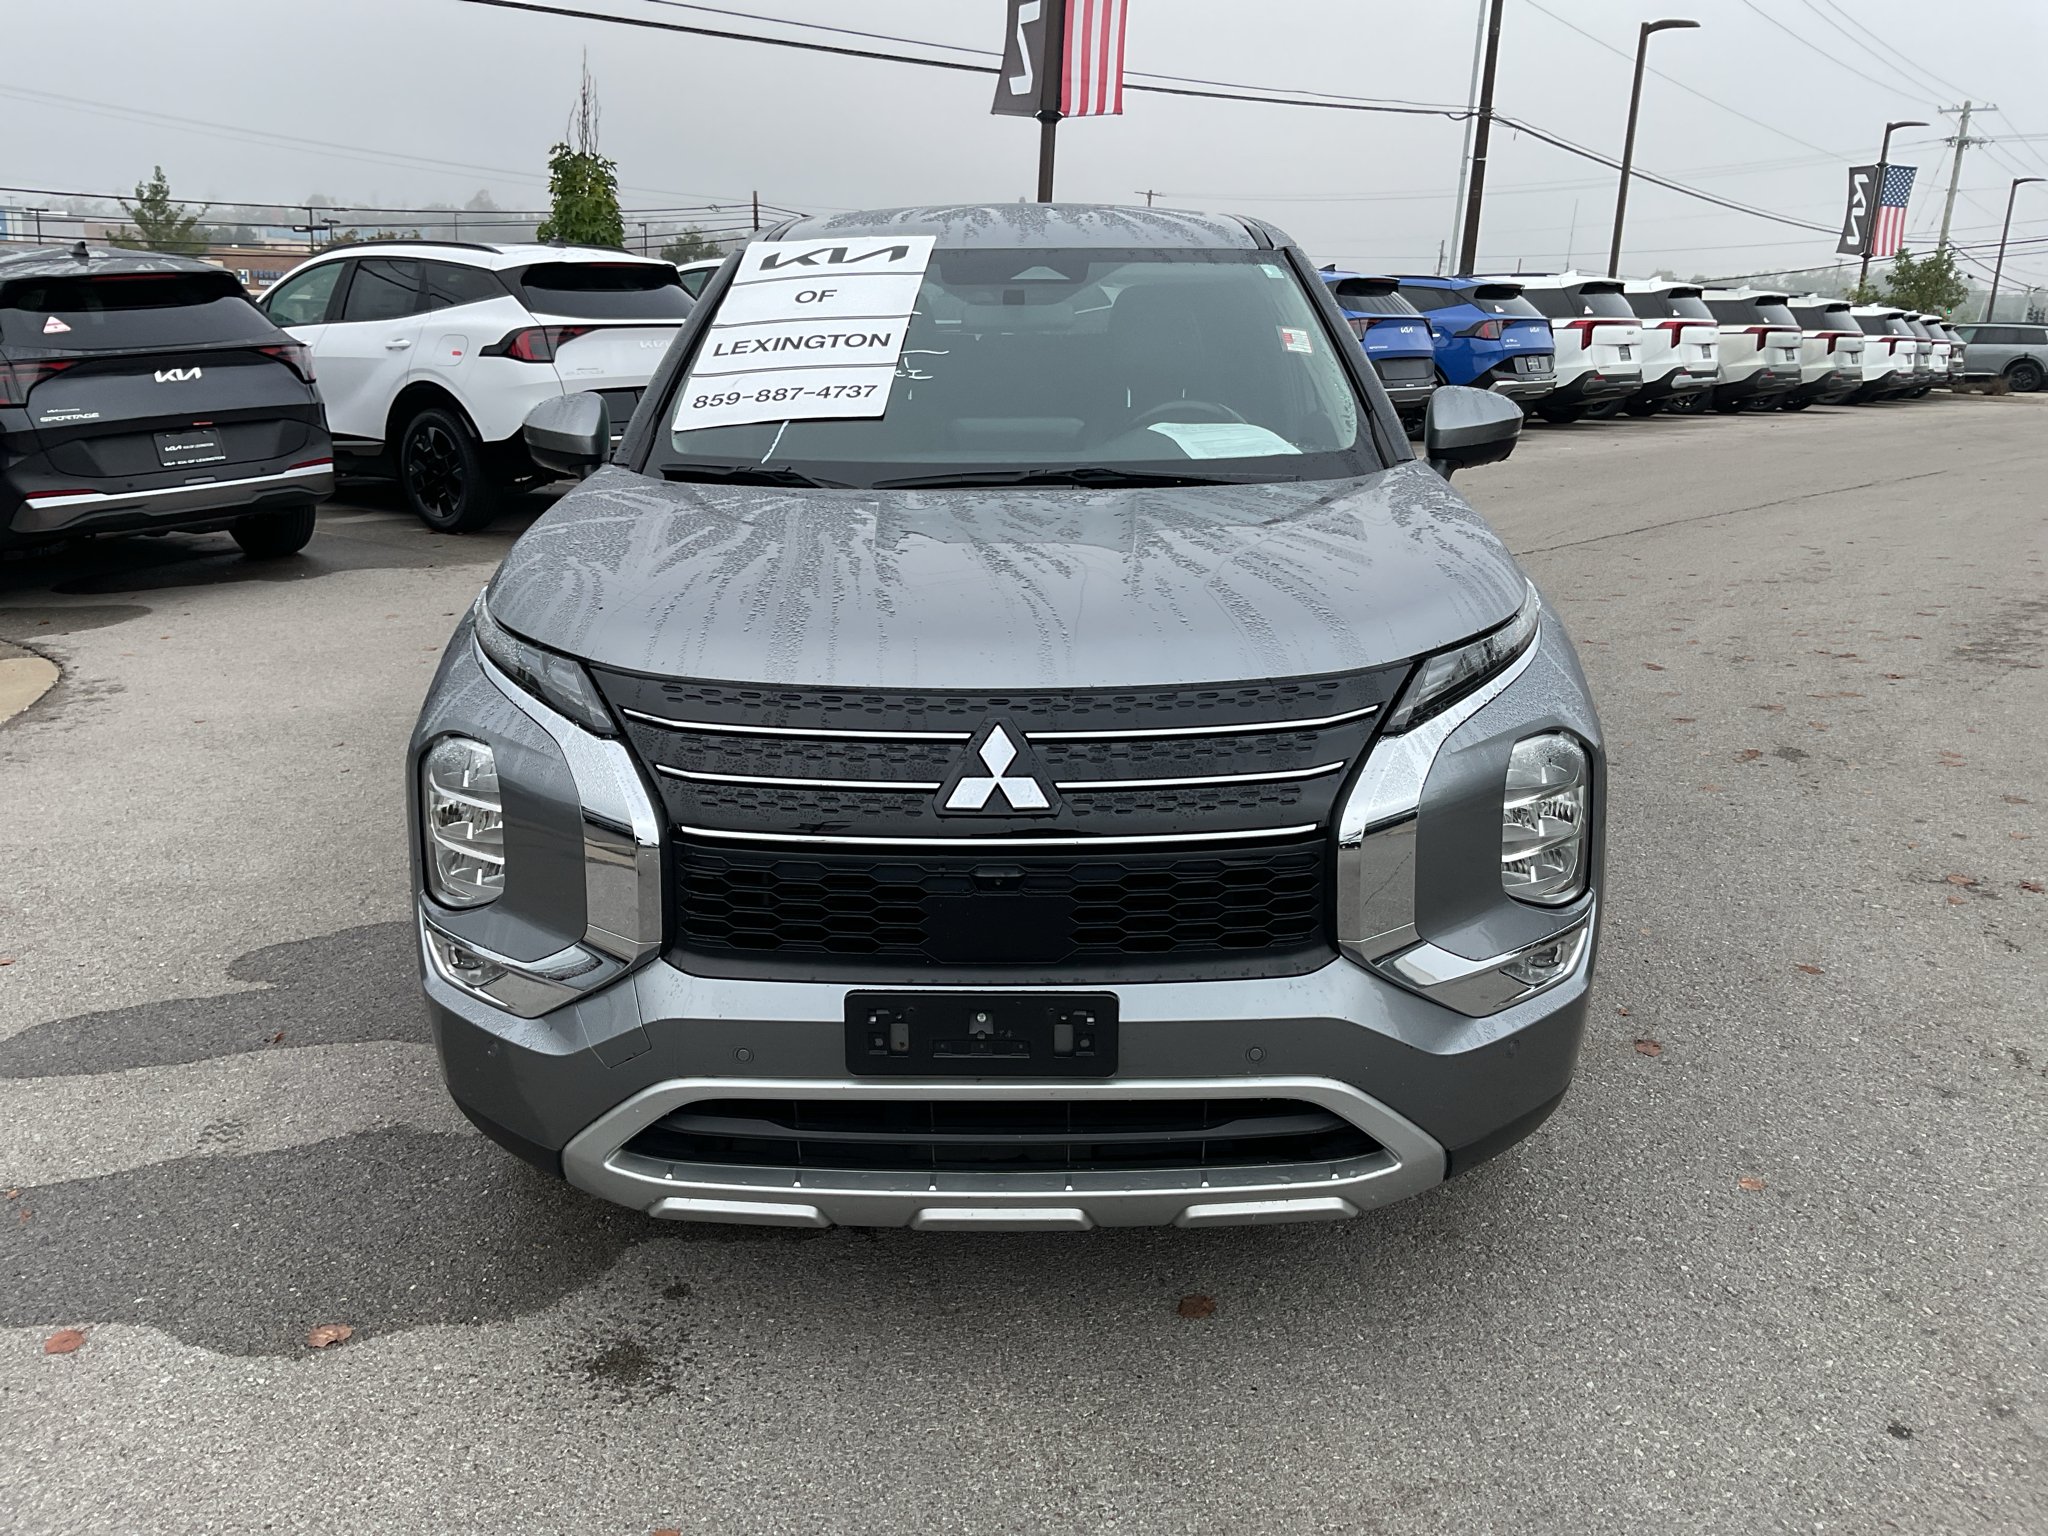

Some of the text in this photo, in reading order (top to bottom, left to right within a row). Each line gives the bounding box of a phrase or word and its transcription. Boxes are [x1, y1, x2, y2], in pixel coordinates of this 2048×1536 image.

[759, 245, 910, 271] KIA
[794, 289, 838, 304] OF
[712, 333, 892, 357] LEXINGTON
[154, 367, 202, 383] KIA
[692, 384, 878, 410] 859-887-4737
[40, 412, 100, 423] SPORTAGE
